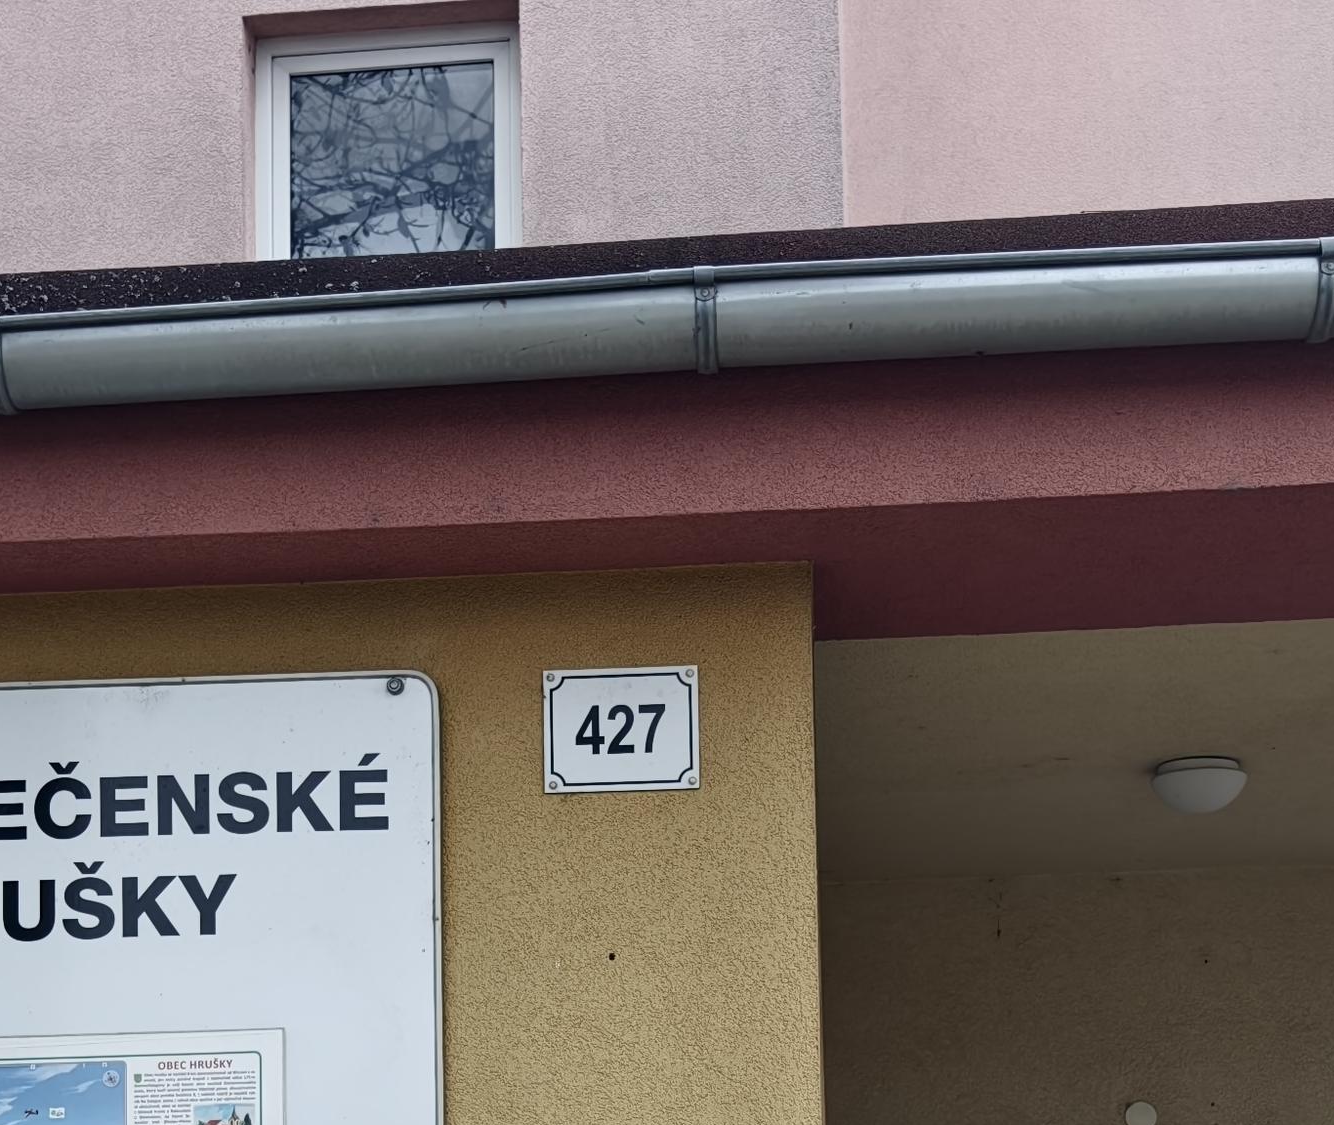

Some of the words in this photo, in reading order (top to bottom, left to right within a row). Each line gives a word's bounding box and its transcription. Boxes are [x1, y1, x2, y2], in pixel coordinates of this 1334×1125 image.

[575, 703, 666, 755] 427
[157, 1060, 187, 1071] OBEC
[189, 1058, 233, 1071] HRUŠKY
